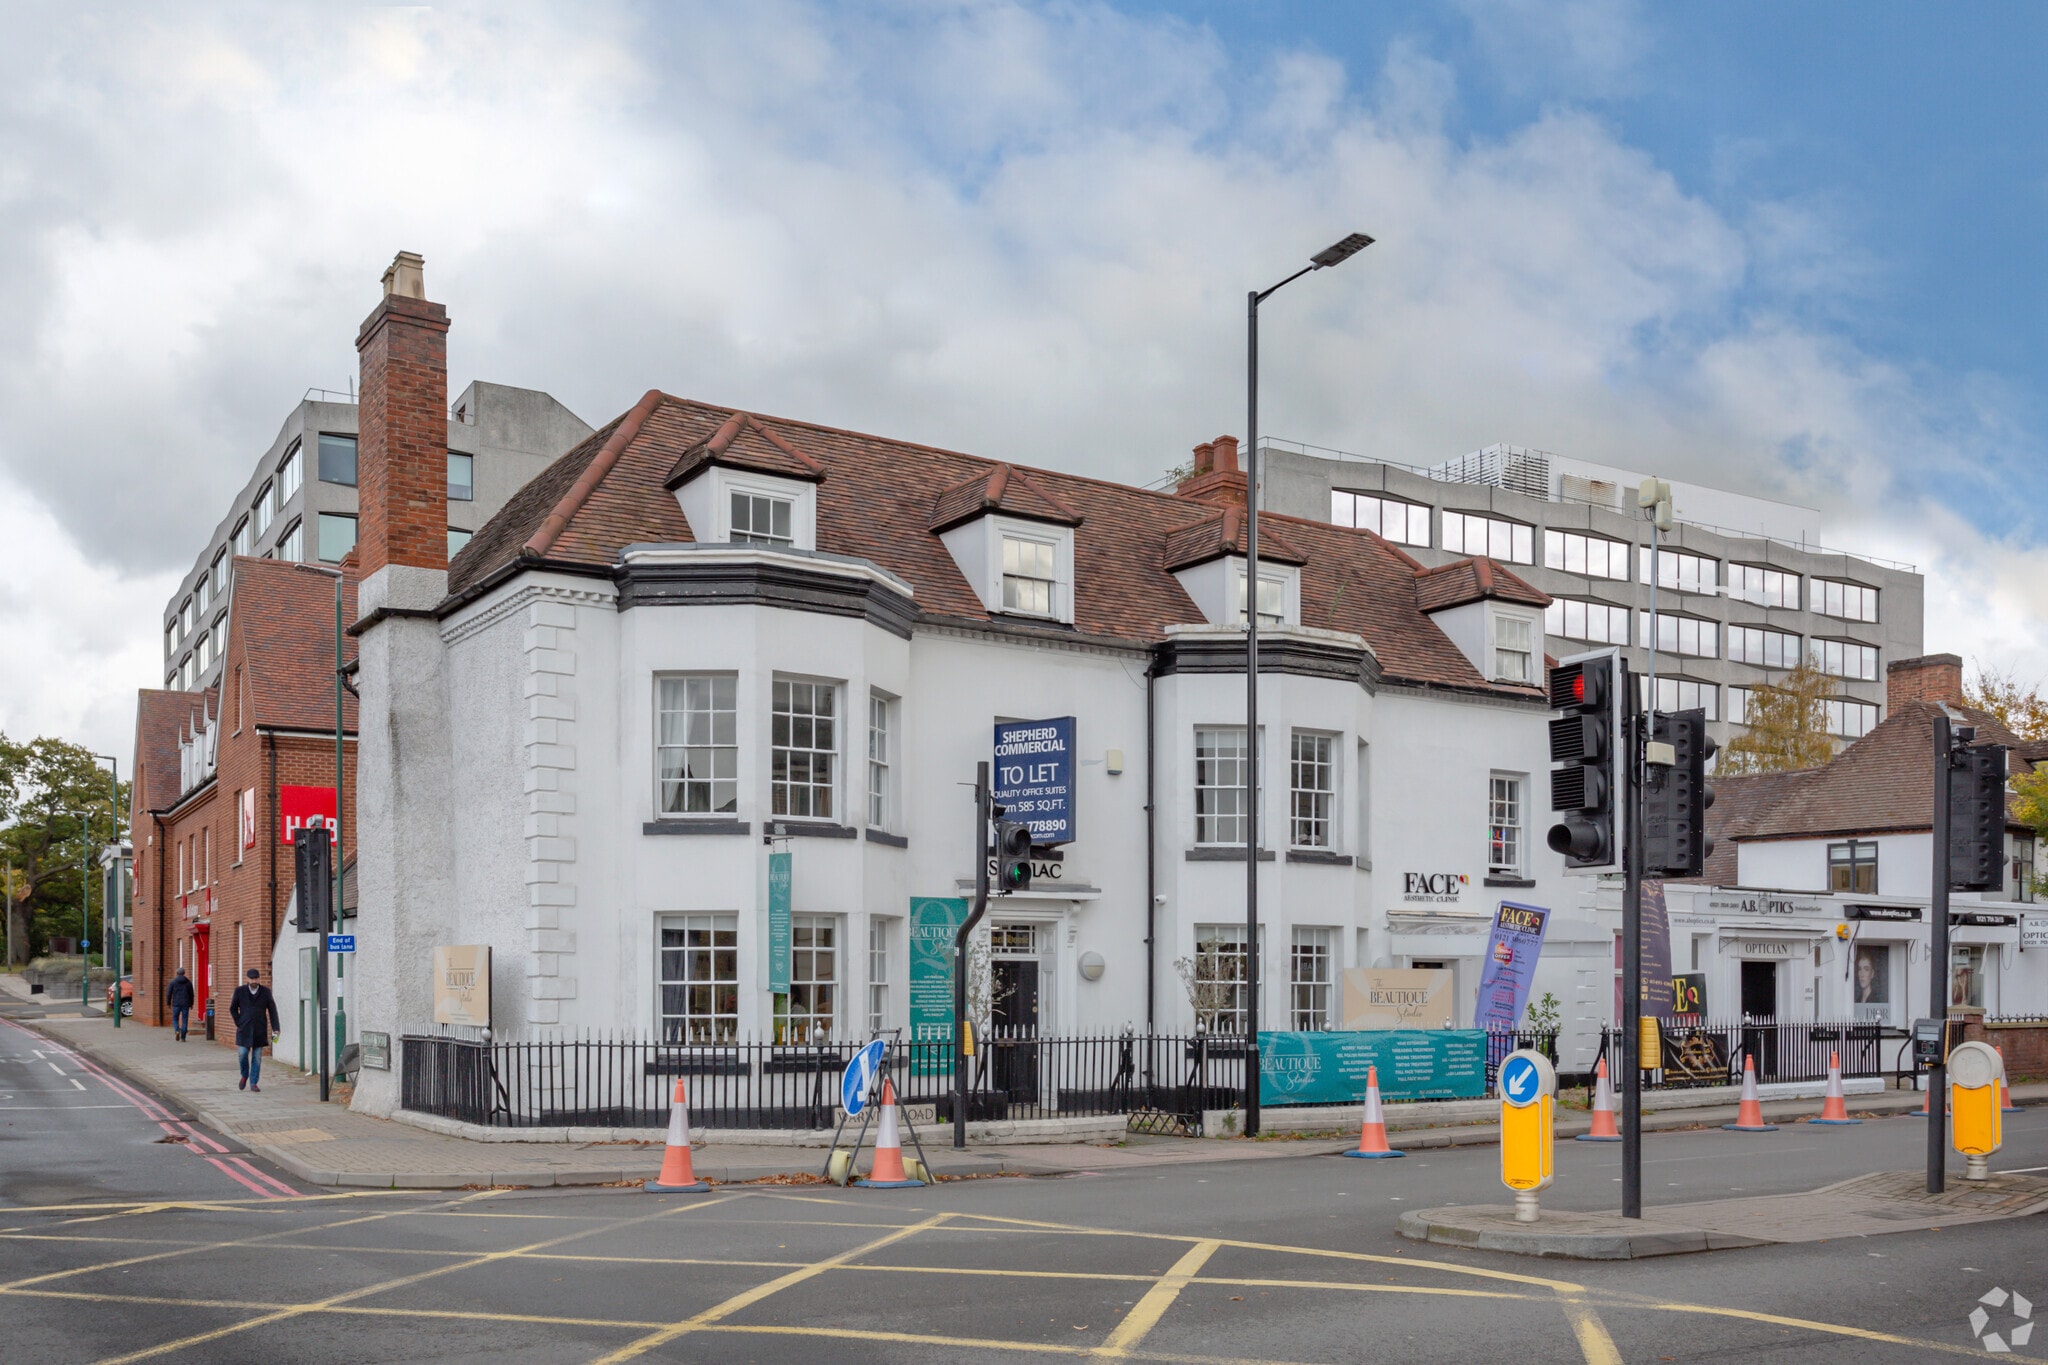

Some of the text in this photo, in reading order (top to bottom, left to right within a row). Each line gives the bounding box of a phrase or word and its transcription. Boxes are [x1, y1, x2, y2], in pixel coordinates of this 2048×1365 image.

[1003, 728, 1057, 743] SHEPHERD
[995, 739, 1065, 756] COMMERCIAL
[1000, 763, 1059, 785] TO LET
[994, 786, 1066, 799] QUALITY OFFICE SUITES
[1018, 801, 1035, 812] 585
[1037, 799, 1066, 811] SQ.FT.
[1404, 873, 1460, 894] FACE
[1437, 895, 1460, 903] CLINIC
[1740, 900, 1758, 912] A.B.
[1500, 907, 1534, 927] FACE
[1745, 944, 1788, 954] OPTICIAN
[1370, 991, 1428, 1007] BEAUTIQUE
[1397, 1004, 1423, 1024] Studio
[1866, 1008, 1889, 1020] DIOR
[1259, 1057, 1321, 1072] BEAUTIQUE
[1286, 1070, 1316, 1090] Studio
[838, 1111, 881, 1122] WARWI
